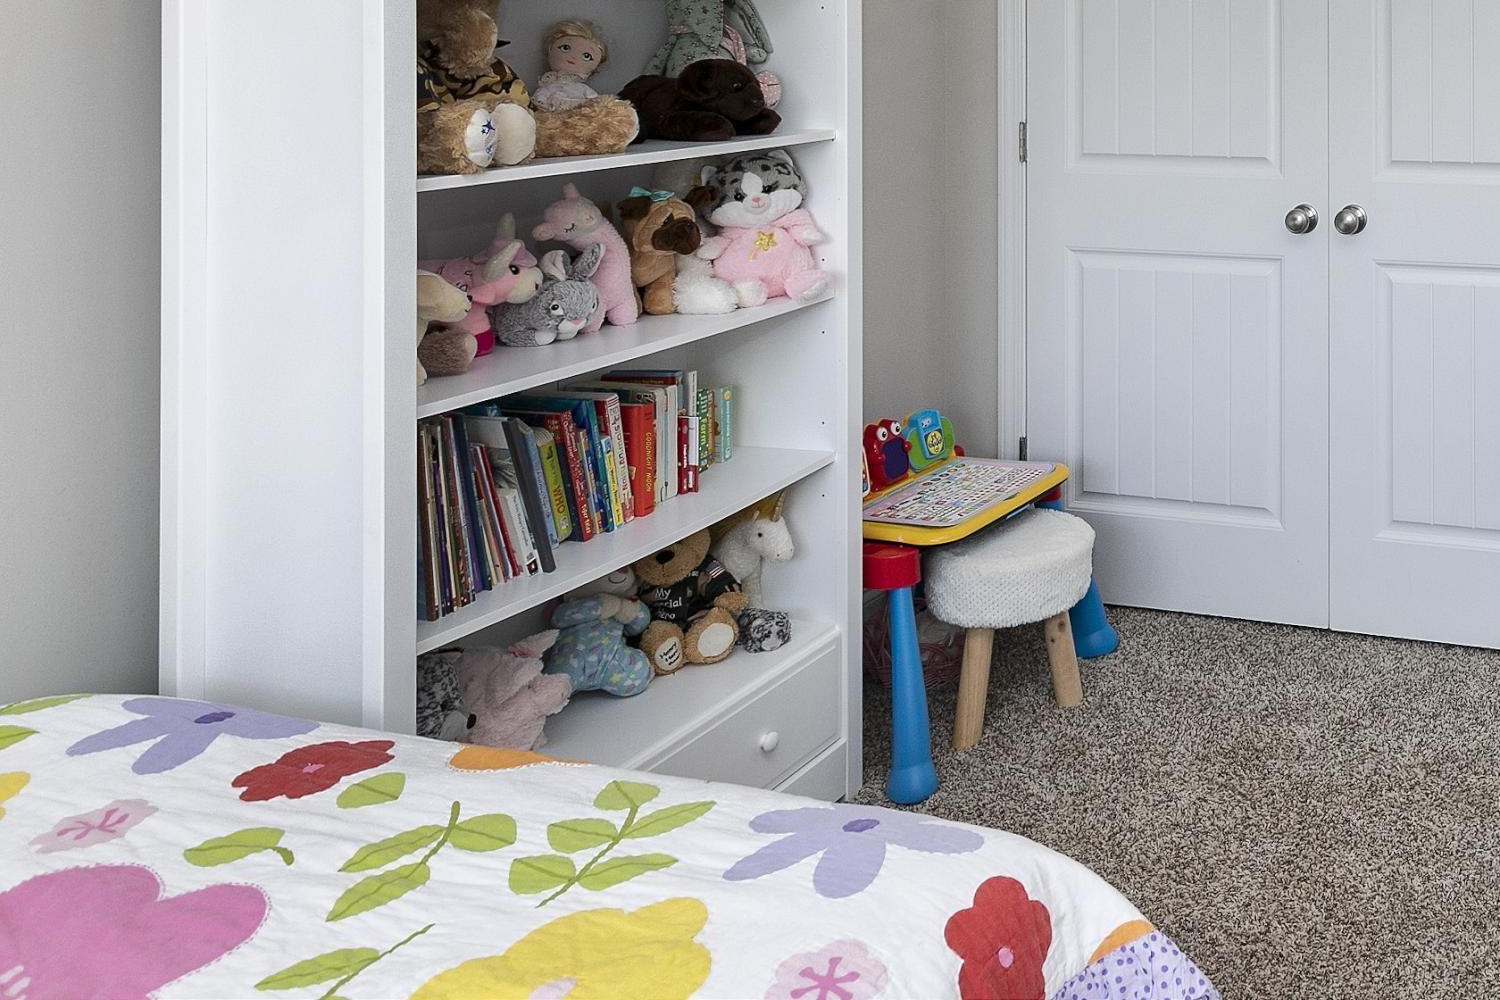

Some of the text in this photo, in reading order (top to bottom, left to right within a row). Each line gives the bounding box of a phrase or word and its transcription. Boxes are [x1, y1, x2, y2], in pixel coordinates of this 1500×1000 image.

[700, 418, 708, 445] Farm
[553, 485, 565, 514] WHO
[655, 587, 672, 600] My
